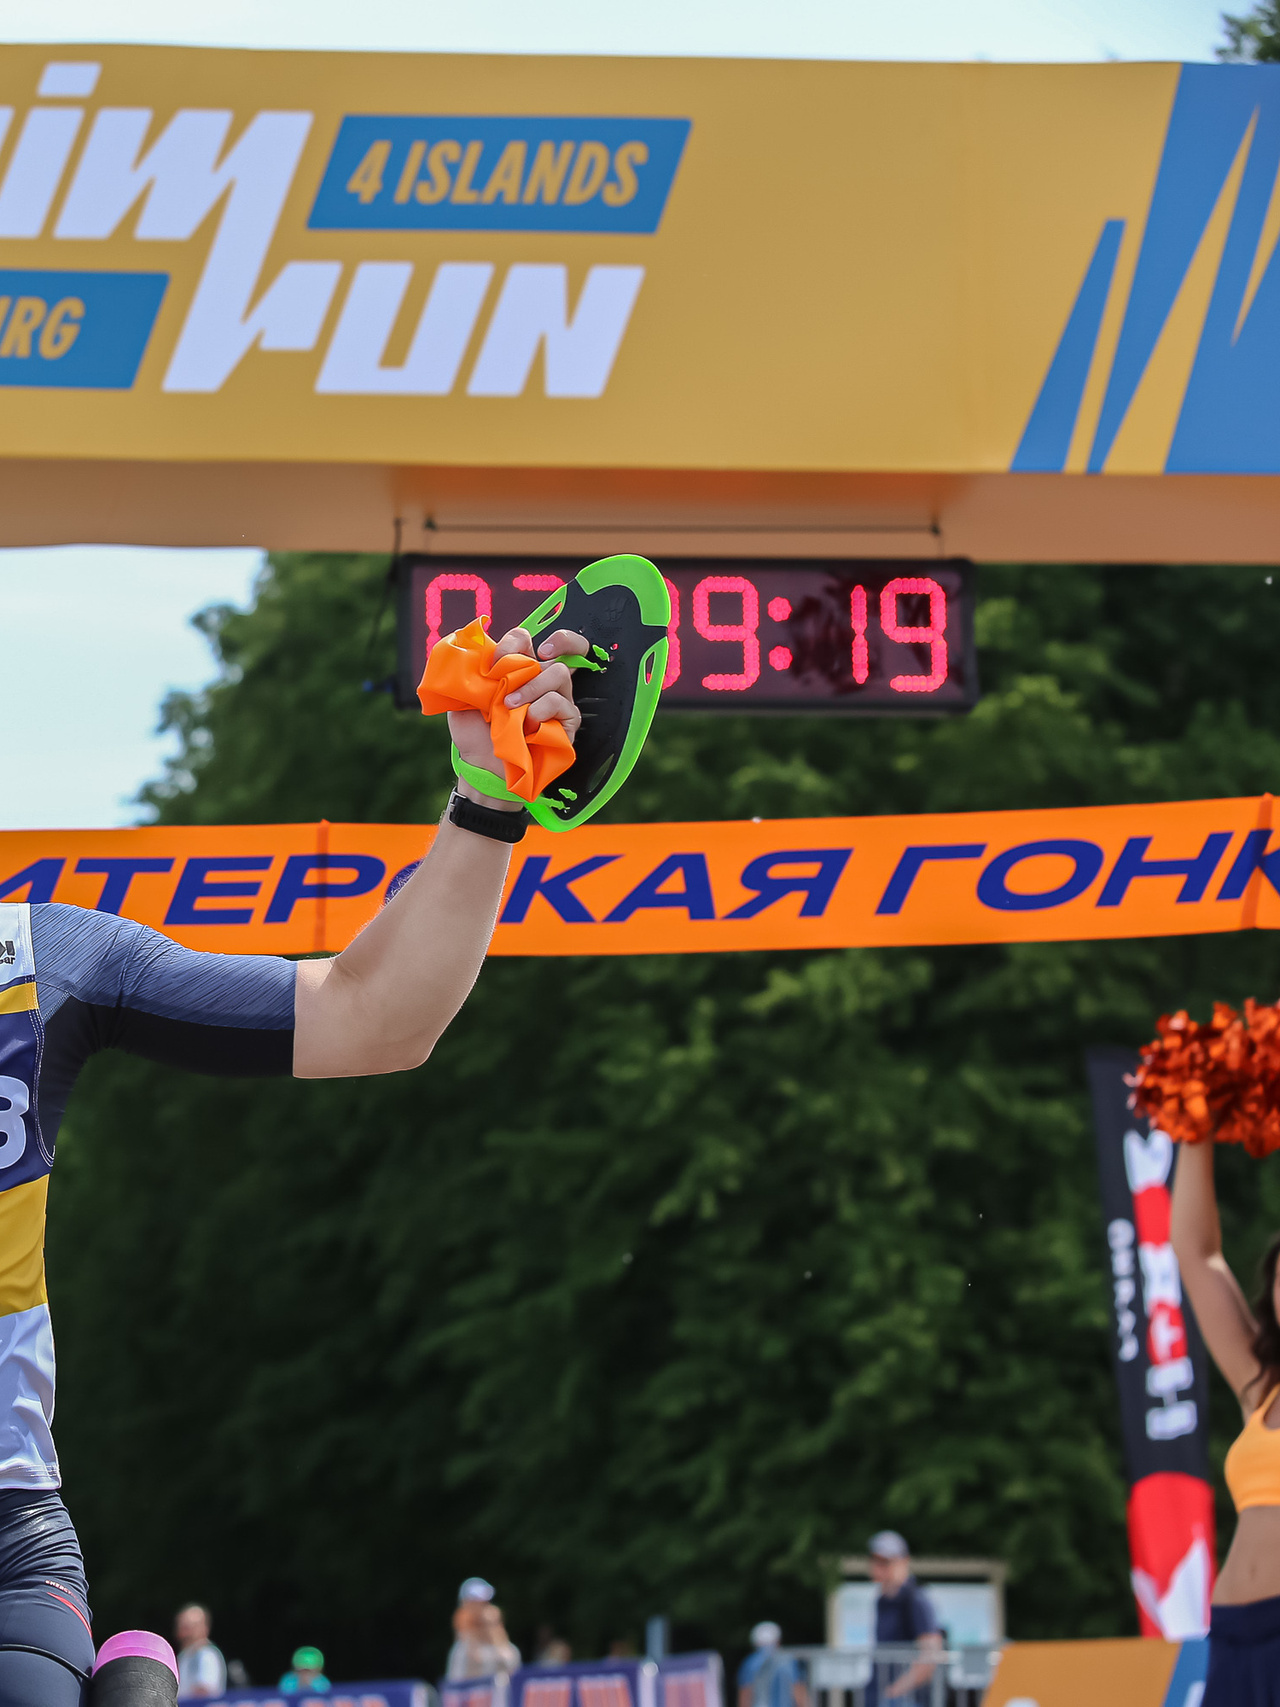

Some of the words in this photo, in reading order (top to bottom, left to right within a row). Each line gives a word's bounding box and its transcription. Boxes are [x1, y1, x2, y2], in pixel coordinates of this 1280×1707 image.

[346, 140, 381, 203] 4
[394, 139, 648, 207] ISLANDS
[875, 828, 1280, 915] ГОНК
